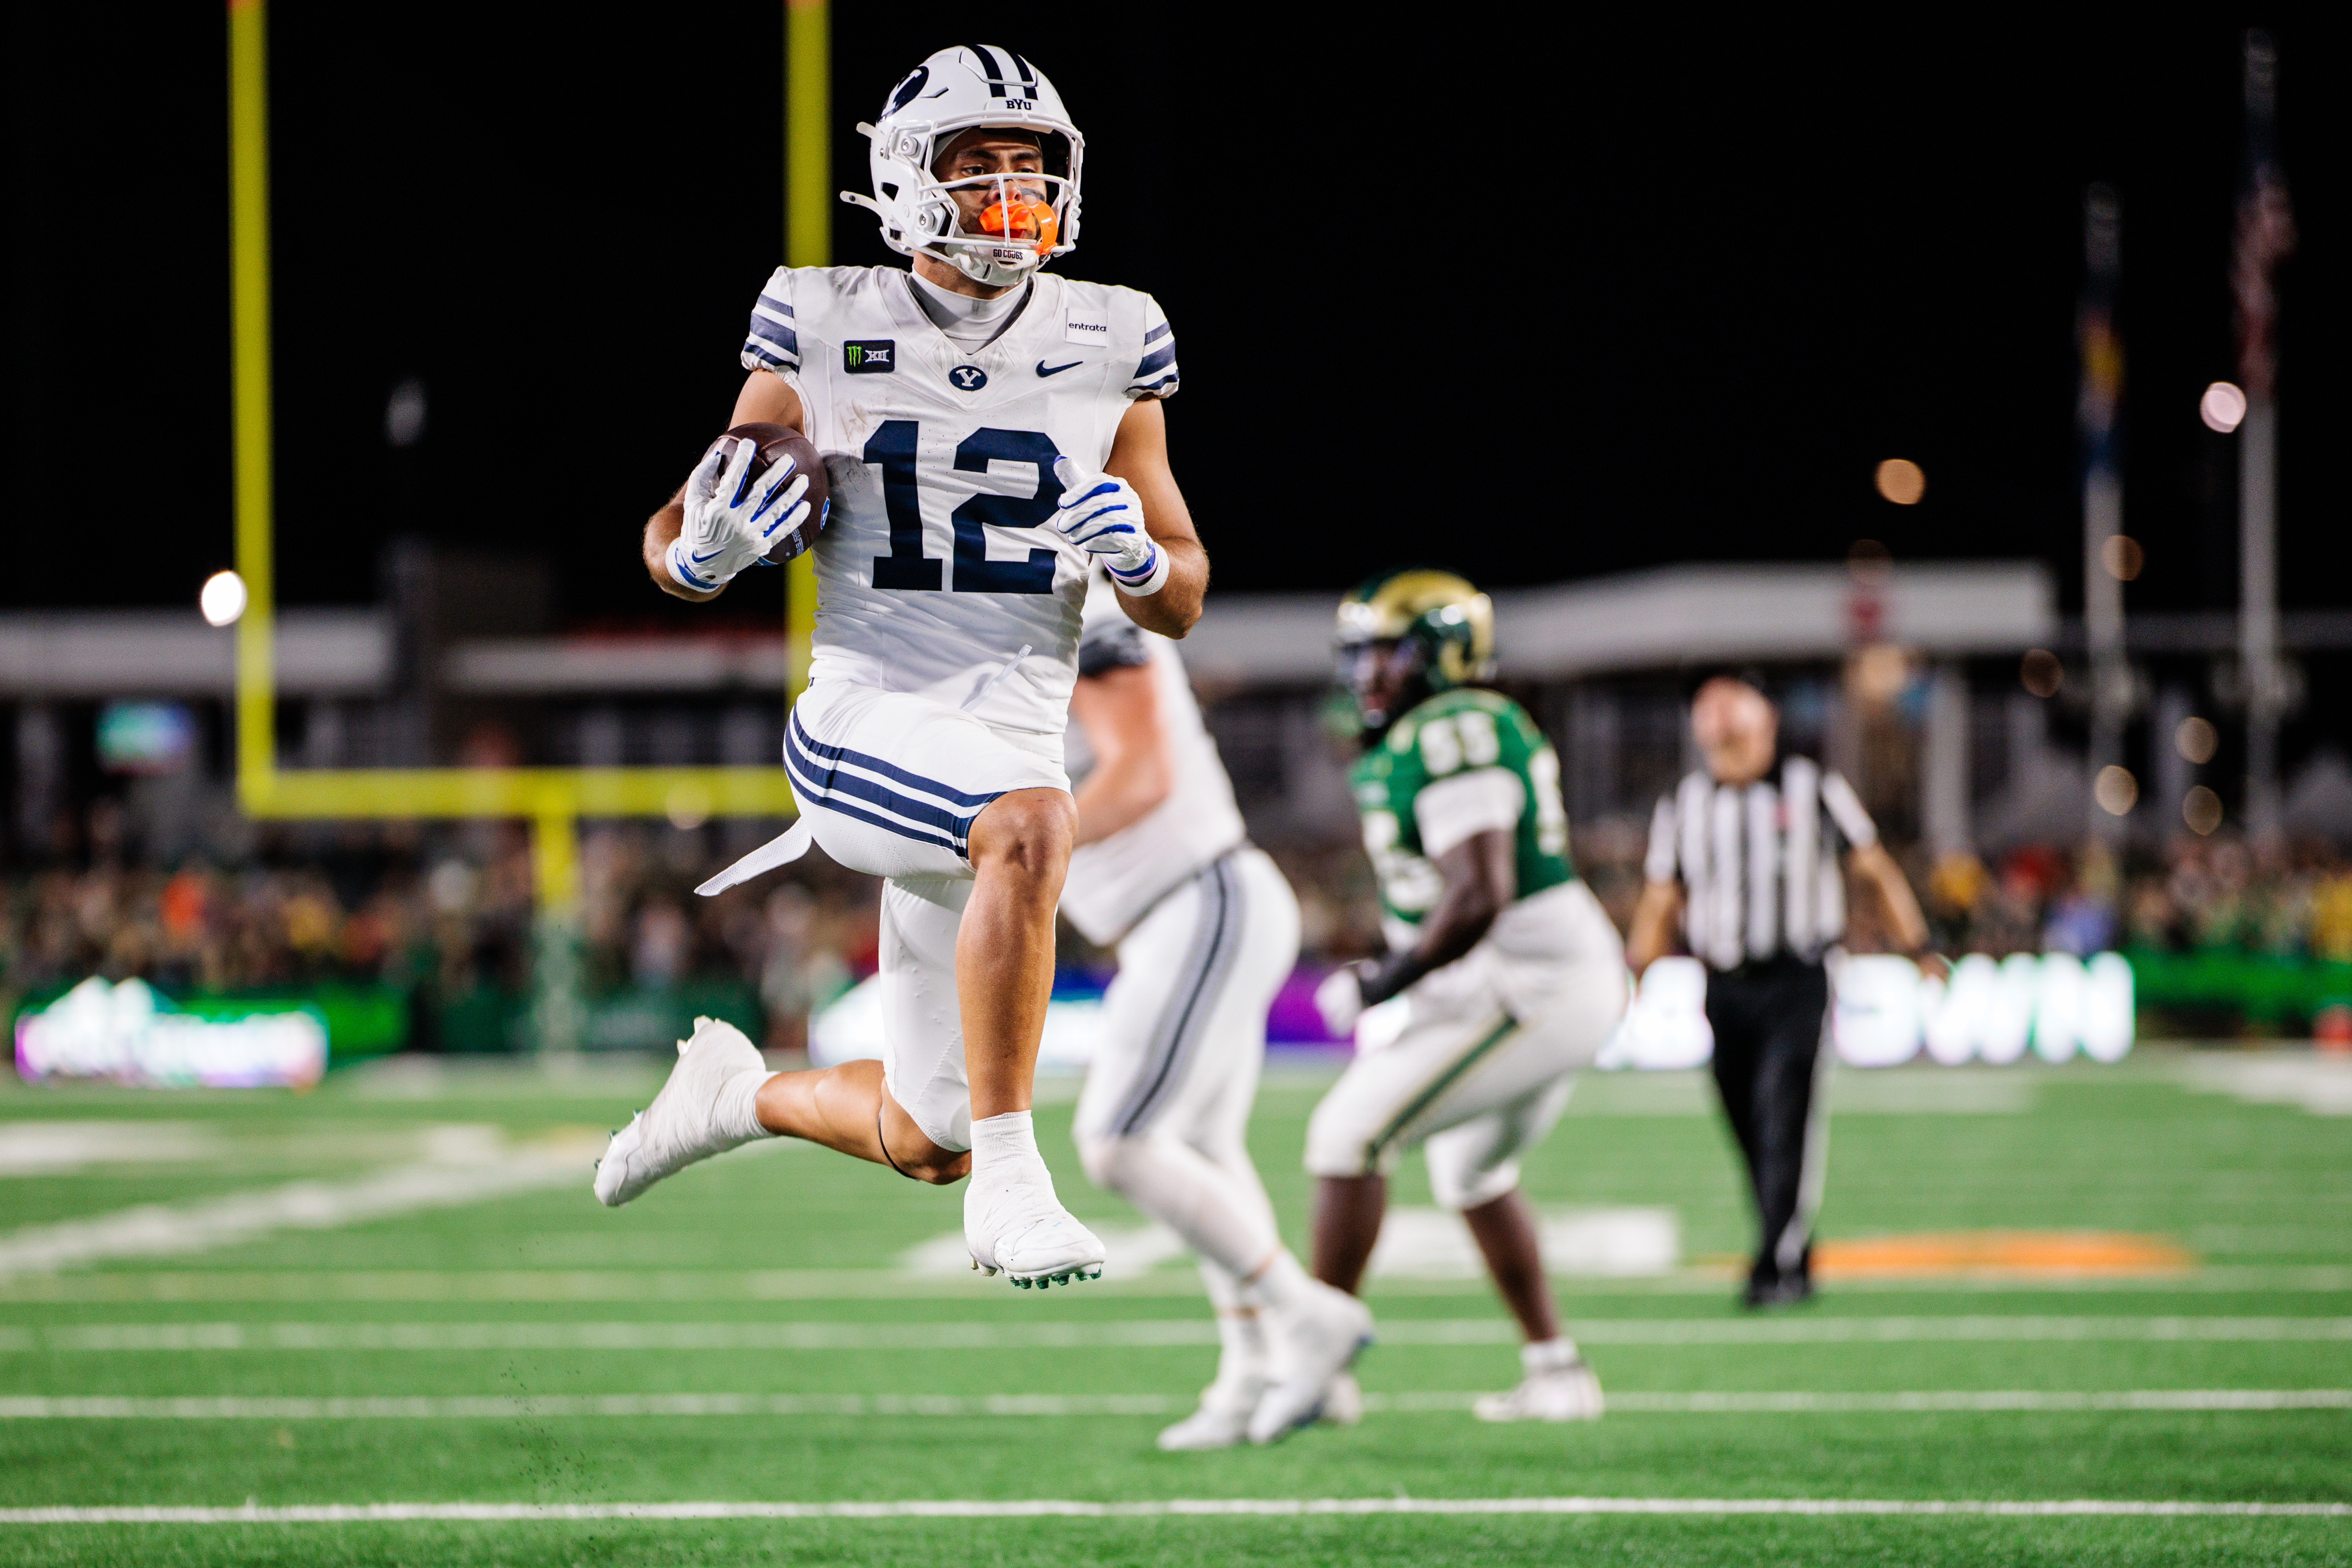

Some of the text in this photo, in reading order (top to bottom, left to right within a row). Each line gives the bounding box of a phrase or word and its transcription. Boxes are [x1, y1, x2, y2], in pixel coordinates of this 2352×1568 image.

[1005, 98, 1032, 110] BYU
[993, 249, 1023, 260] GO COUGS
[1068, 323, 1107, 332] entrata
[956, 368, 982, 387] Y
[862, 420, 1067, 594] 12
